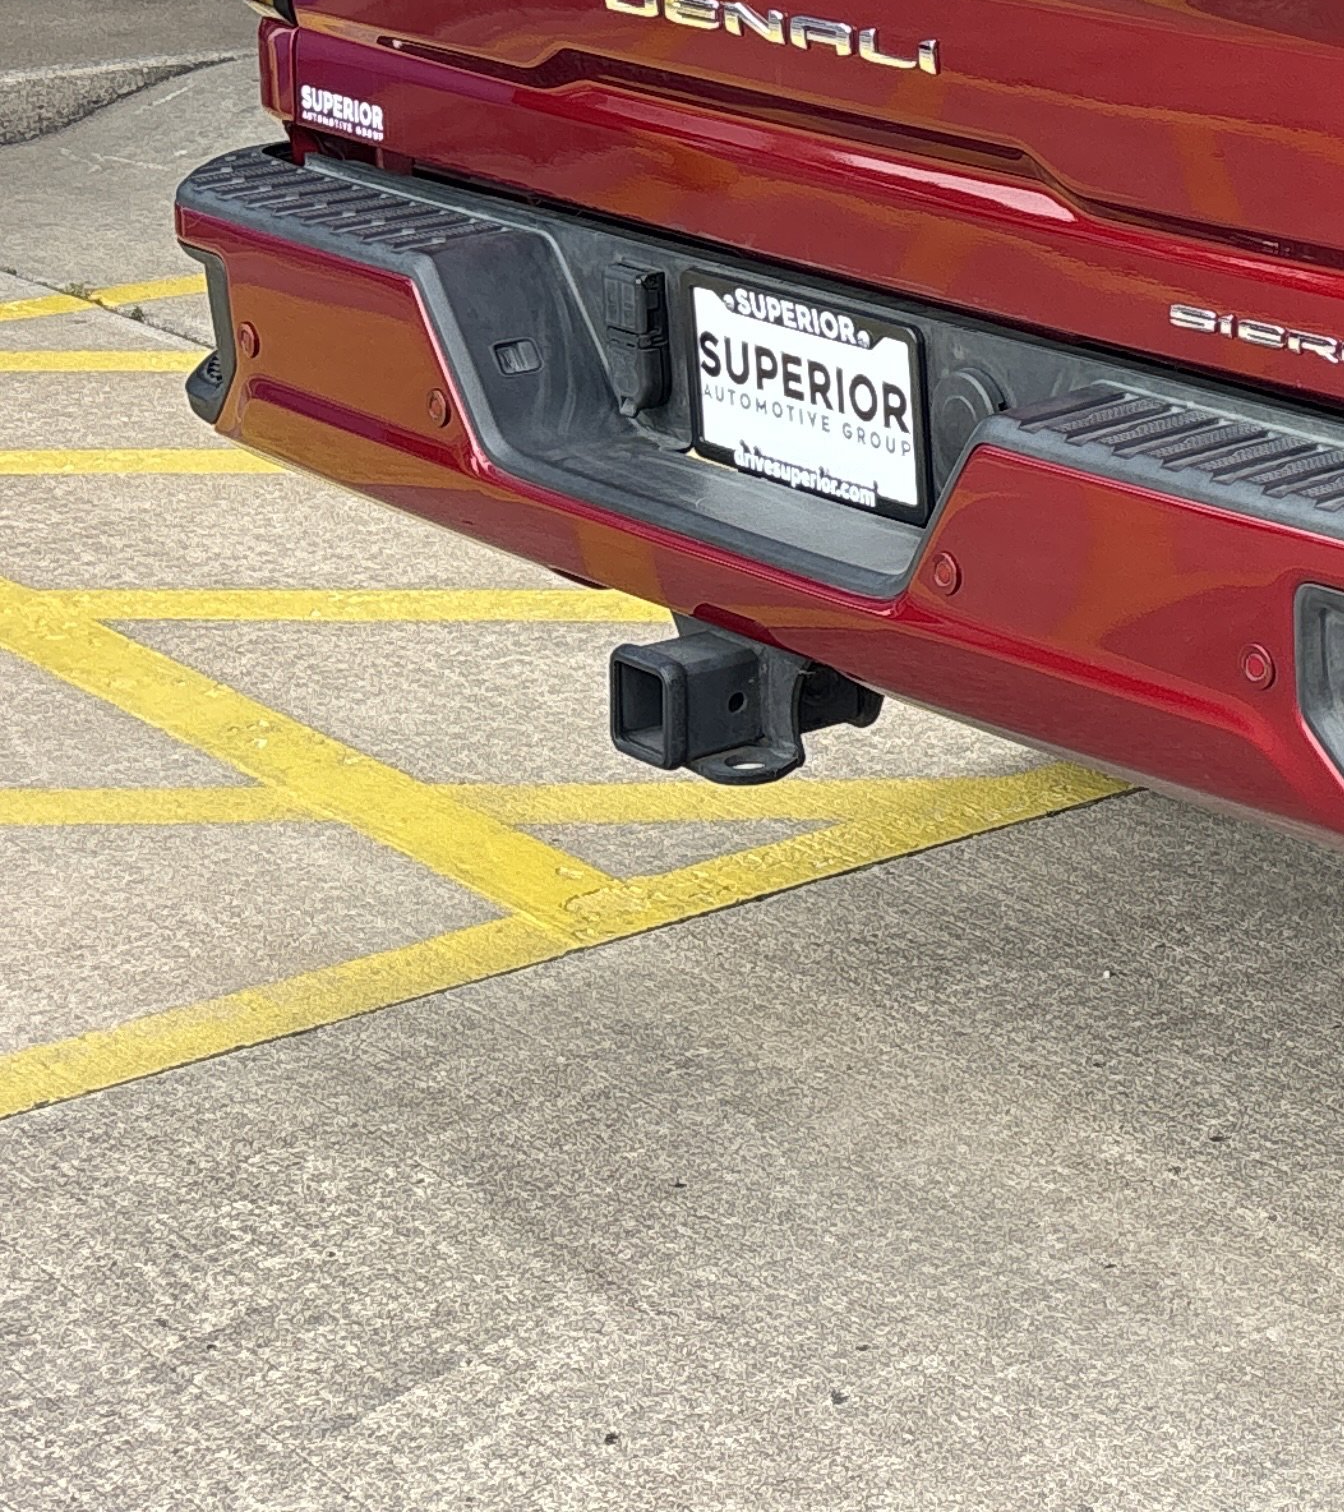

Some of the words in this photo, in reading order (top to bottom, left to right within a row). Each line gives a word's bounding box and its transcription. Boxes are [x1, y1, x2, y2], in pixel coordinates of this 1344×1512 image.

[301, 85, 383, 131] SUPERIOR
[734, 288, 857, 346] SUPERIOR
[700, 331, 910, 434] SUPERIOR
[704, 384, 831, 433] AUTOMOTIVE
[842, 422, 912, 457] GROUP
[734, 446, 877, 508] drivesuperior.com
